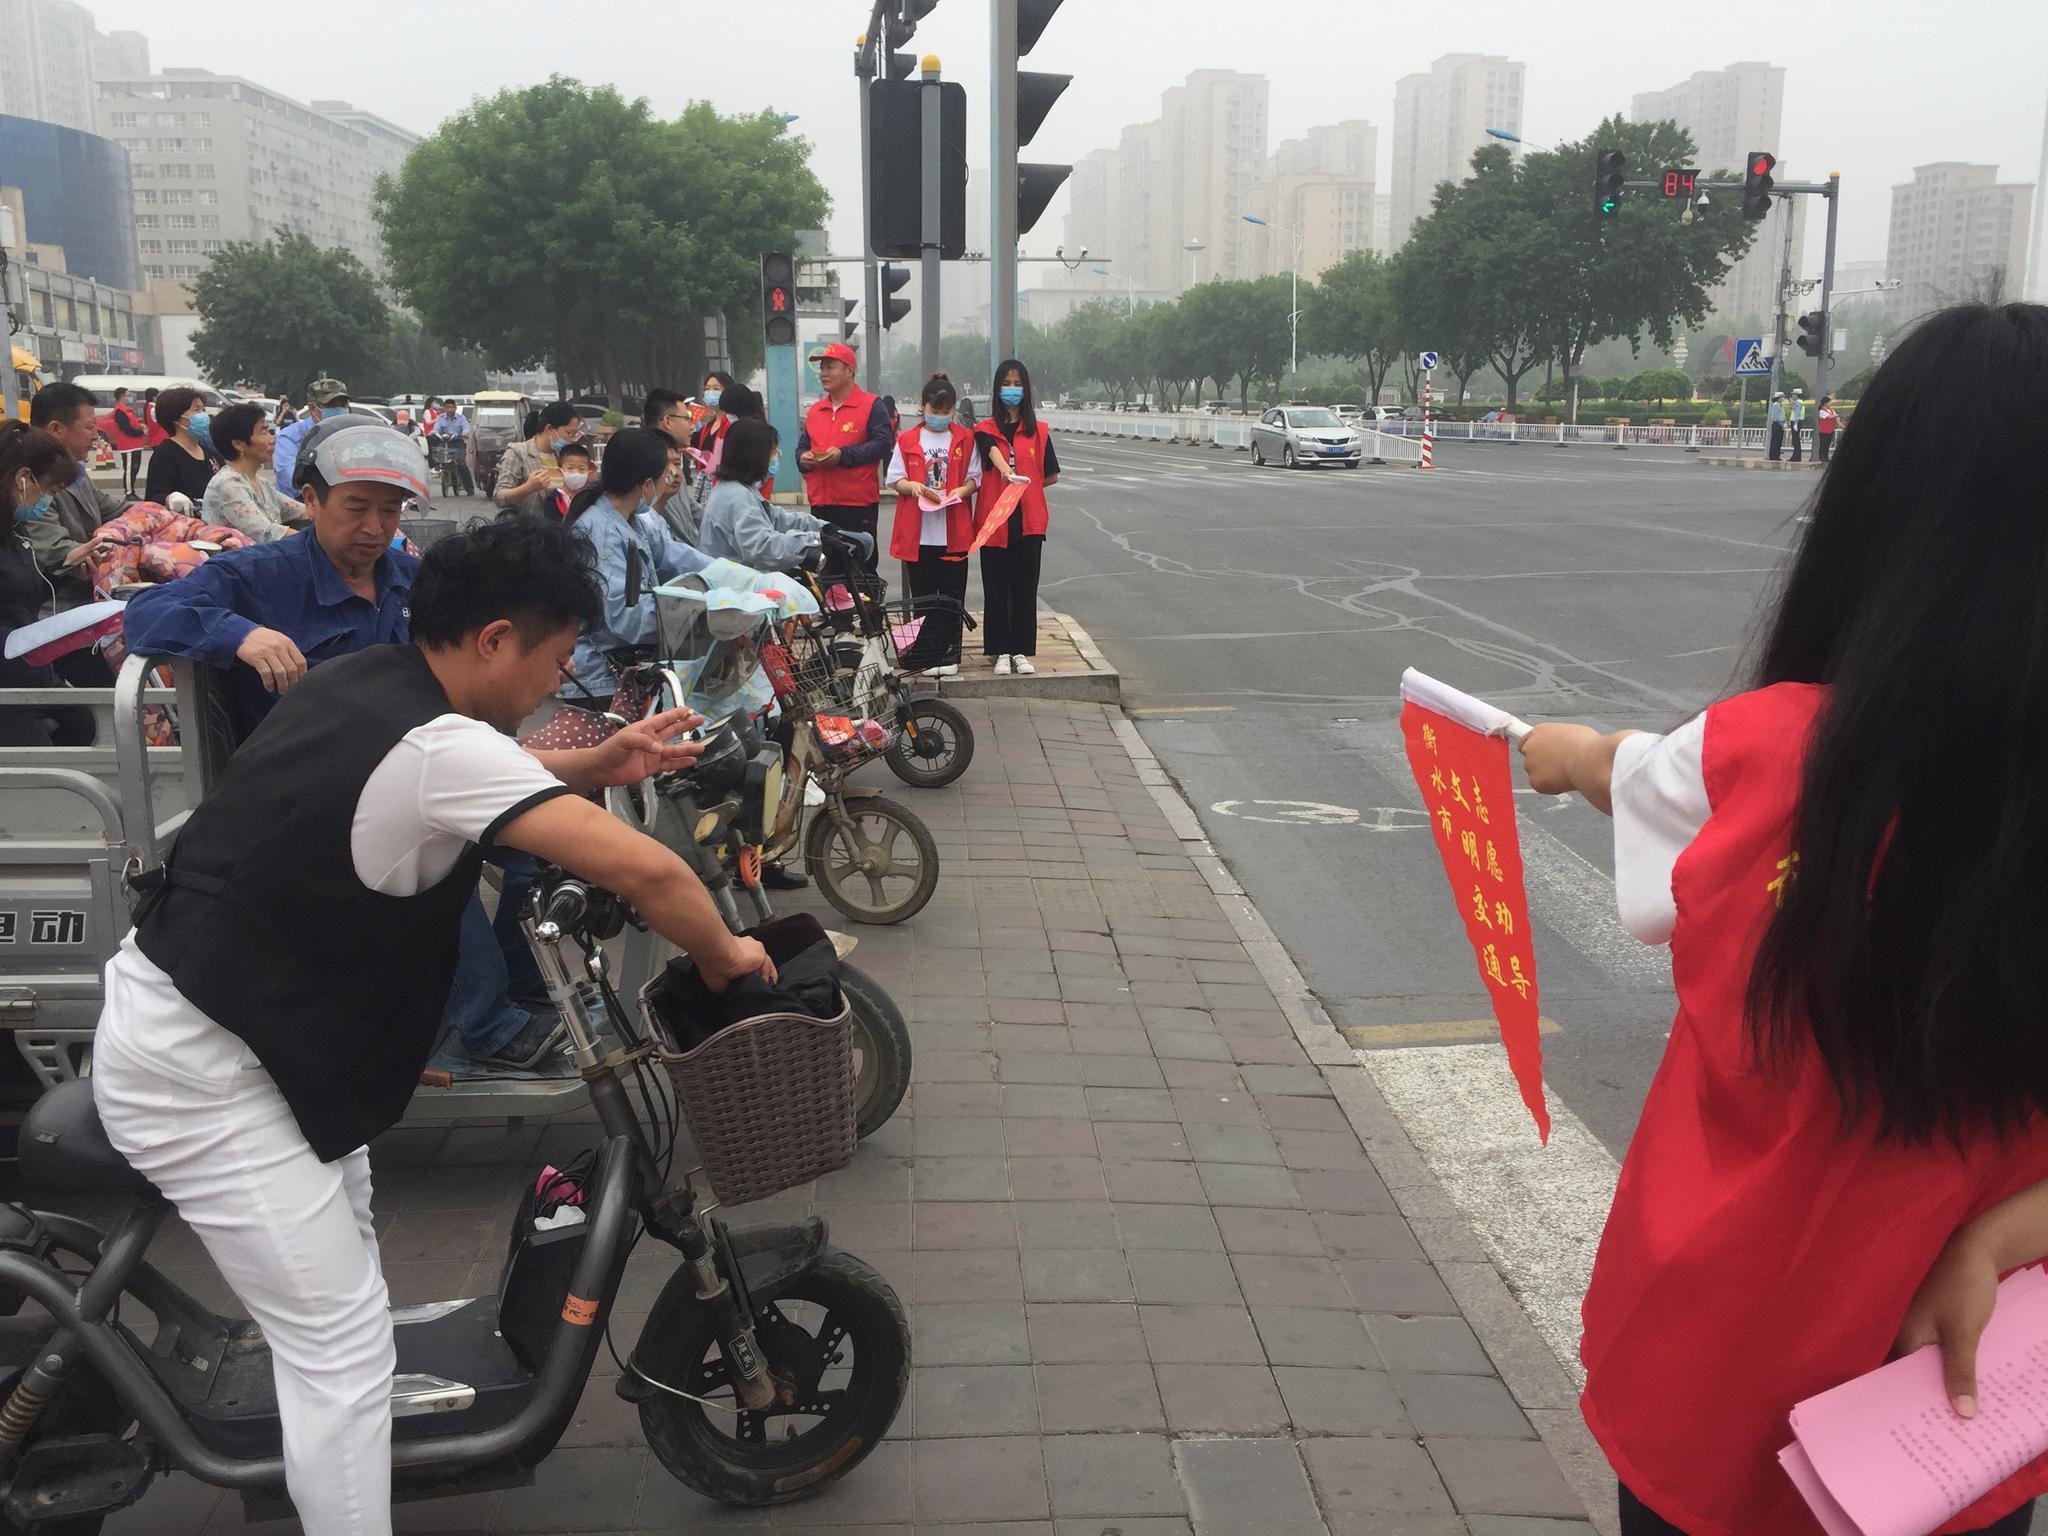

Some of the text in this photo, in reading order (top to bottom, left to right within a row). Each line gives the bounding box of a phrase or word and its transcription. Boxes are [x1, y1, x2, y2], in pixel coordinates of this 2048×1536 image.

[1664, 172, 1694, 197] 84
[1451, 768, 1508, 988] 文明交通
[1472, 775, 1532, 1000] 志愿劝导
